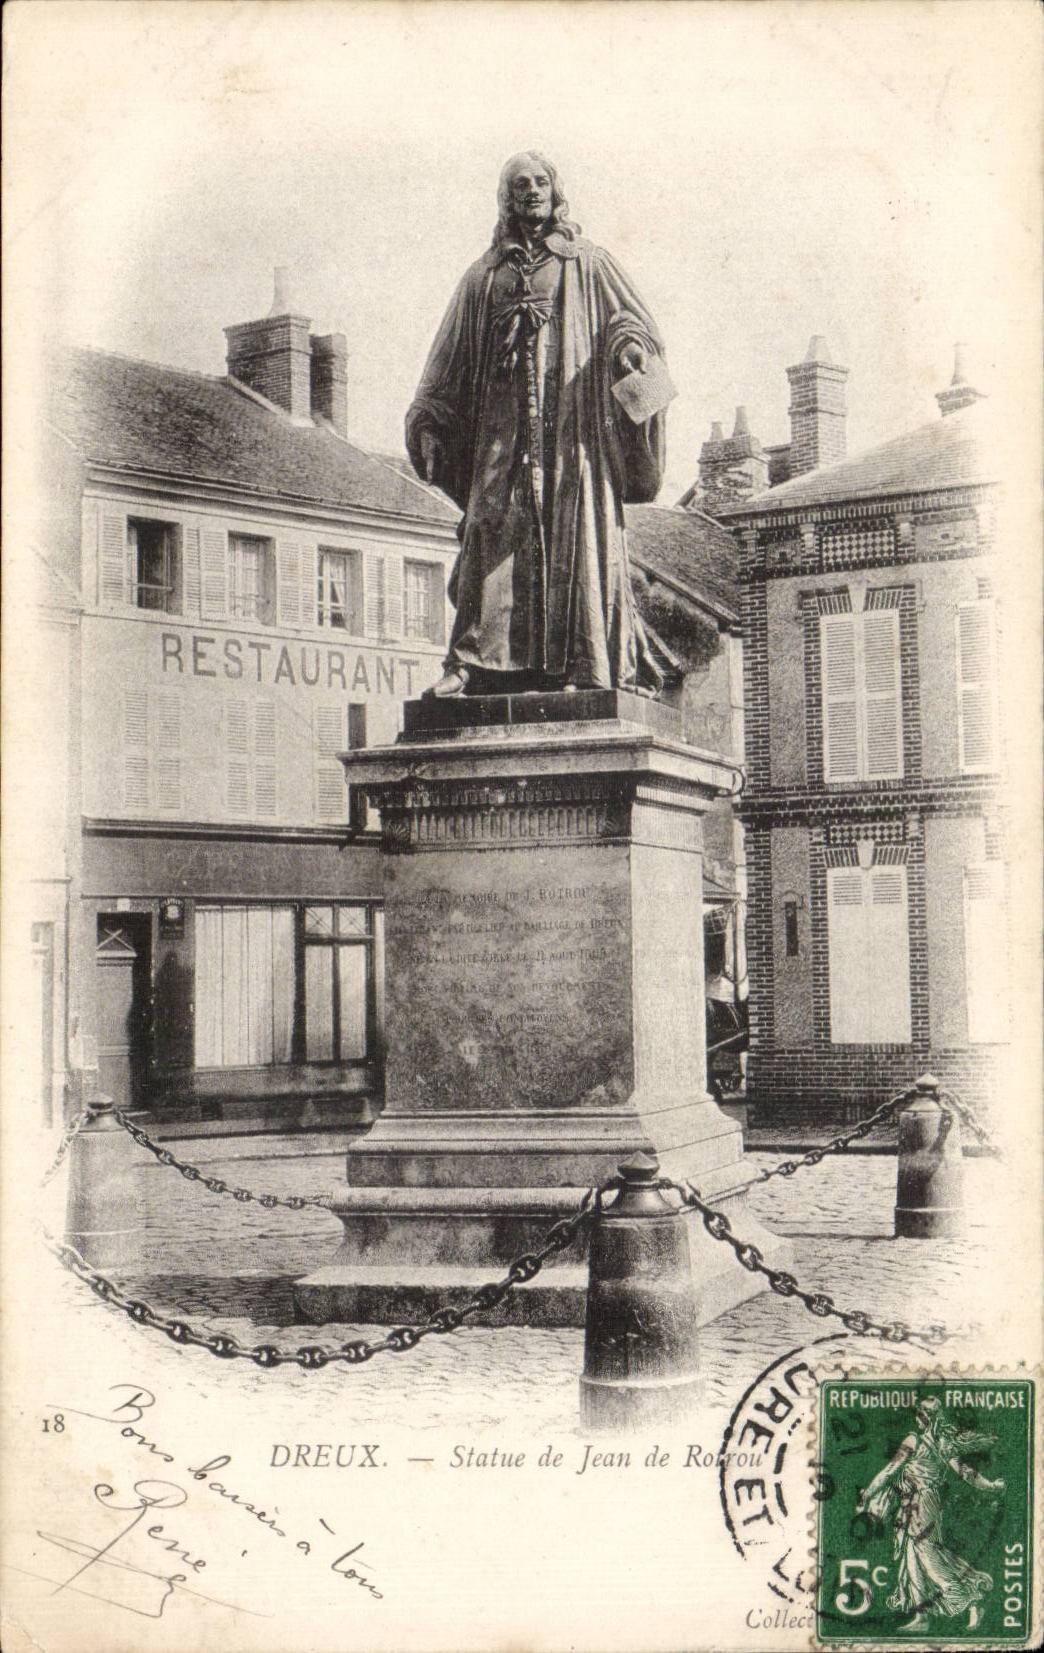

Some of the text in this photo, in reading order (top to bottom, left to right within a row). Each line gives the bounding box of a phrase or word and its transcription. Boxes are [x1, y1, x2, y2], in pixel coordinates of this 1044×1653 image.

[161, 633, 420, 696] RESTAURANT
[945, 1389, 1027, 1411] FRANÇAISE
[1004, 1542, 1024, 1628] POSTES
